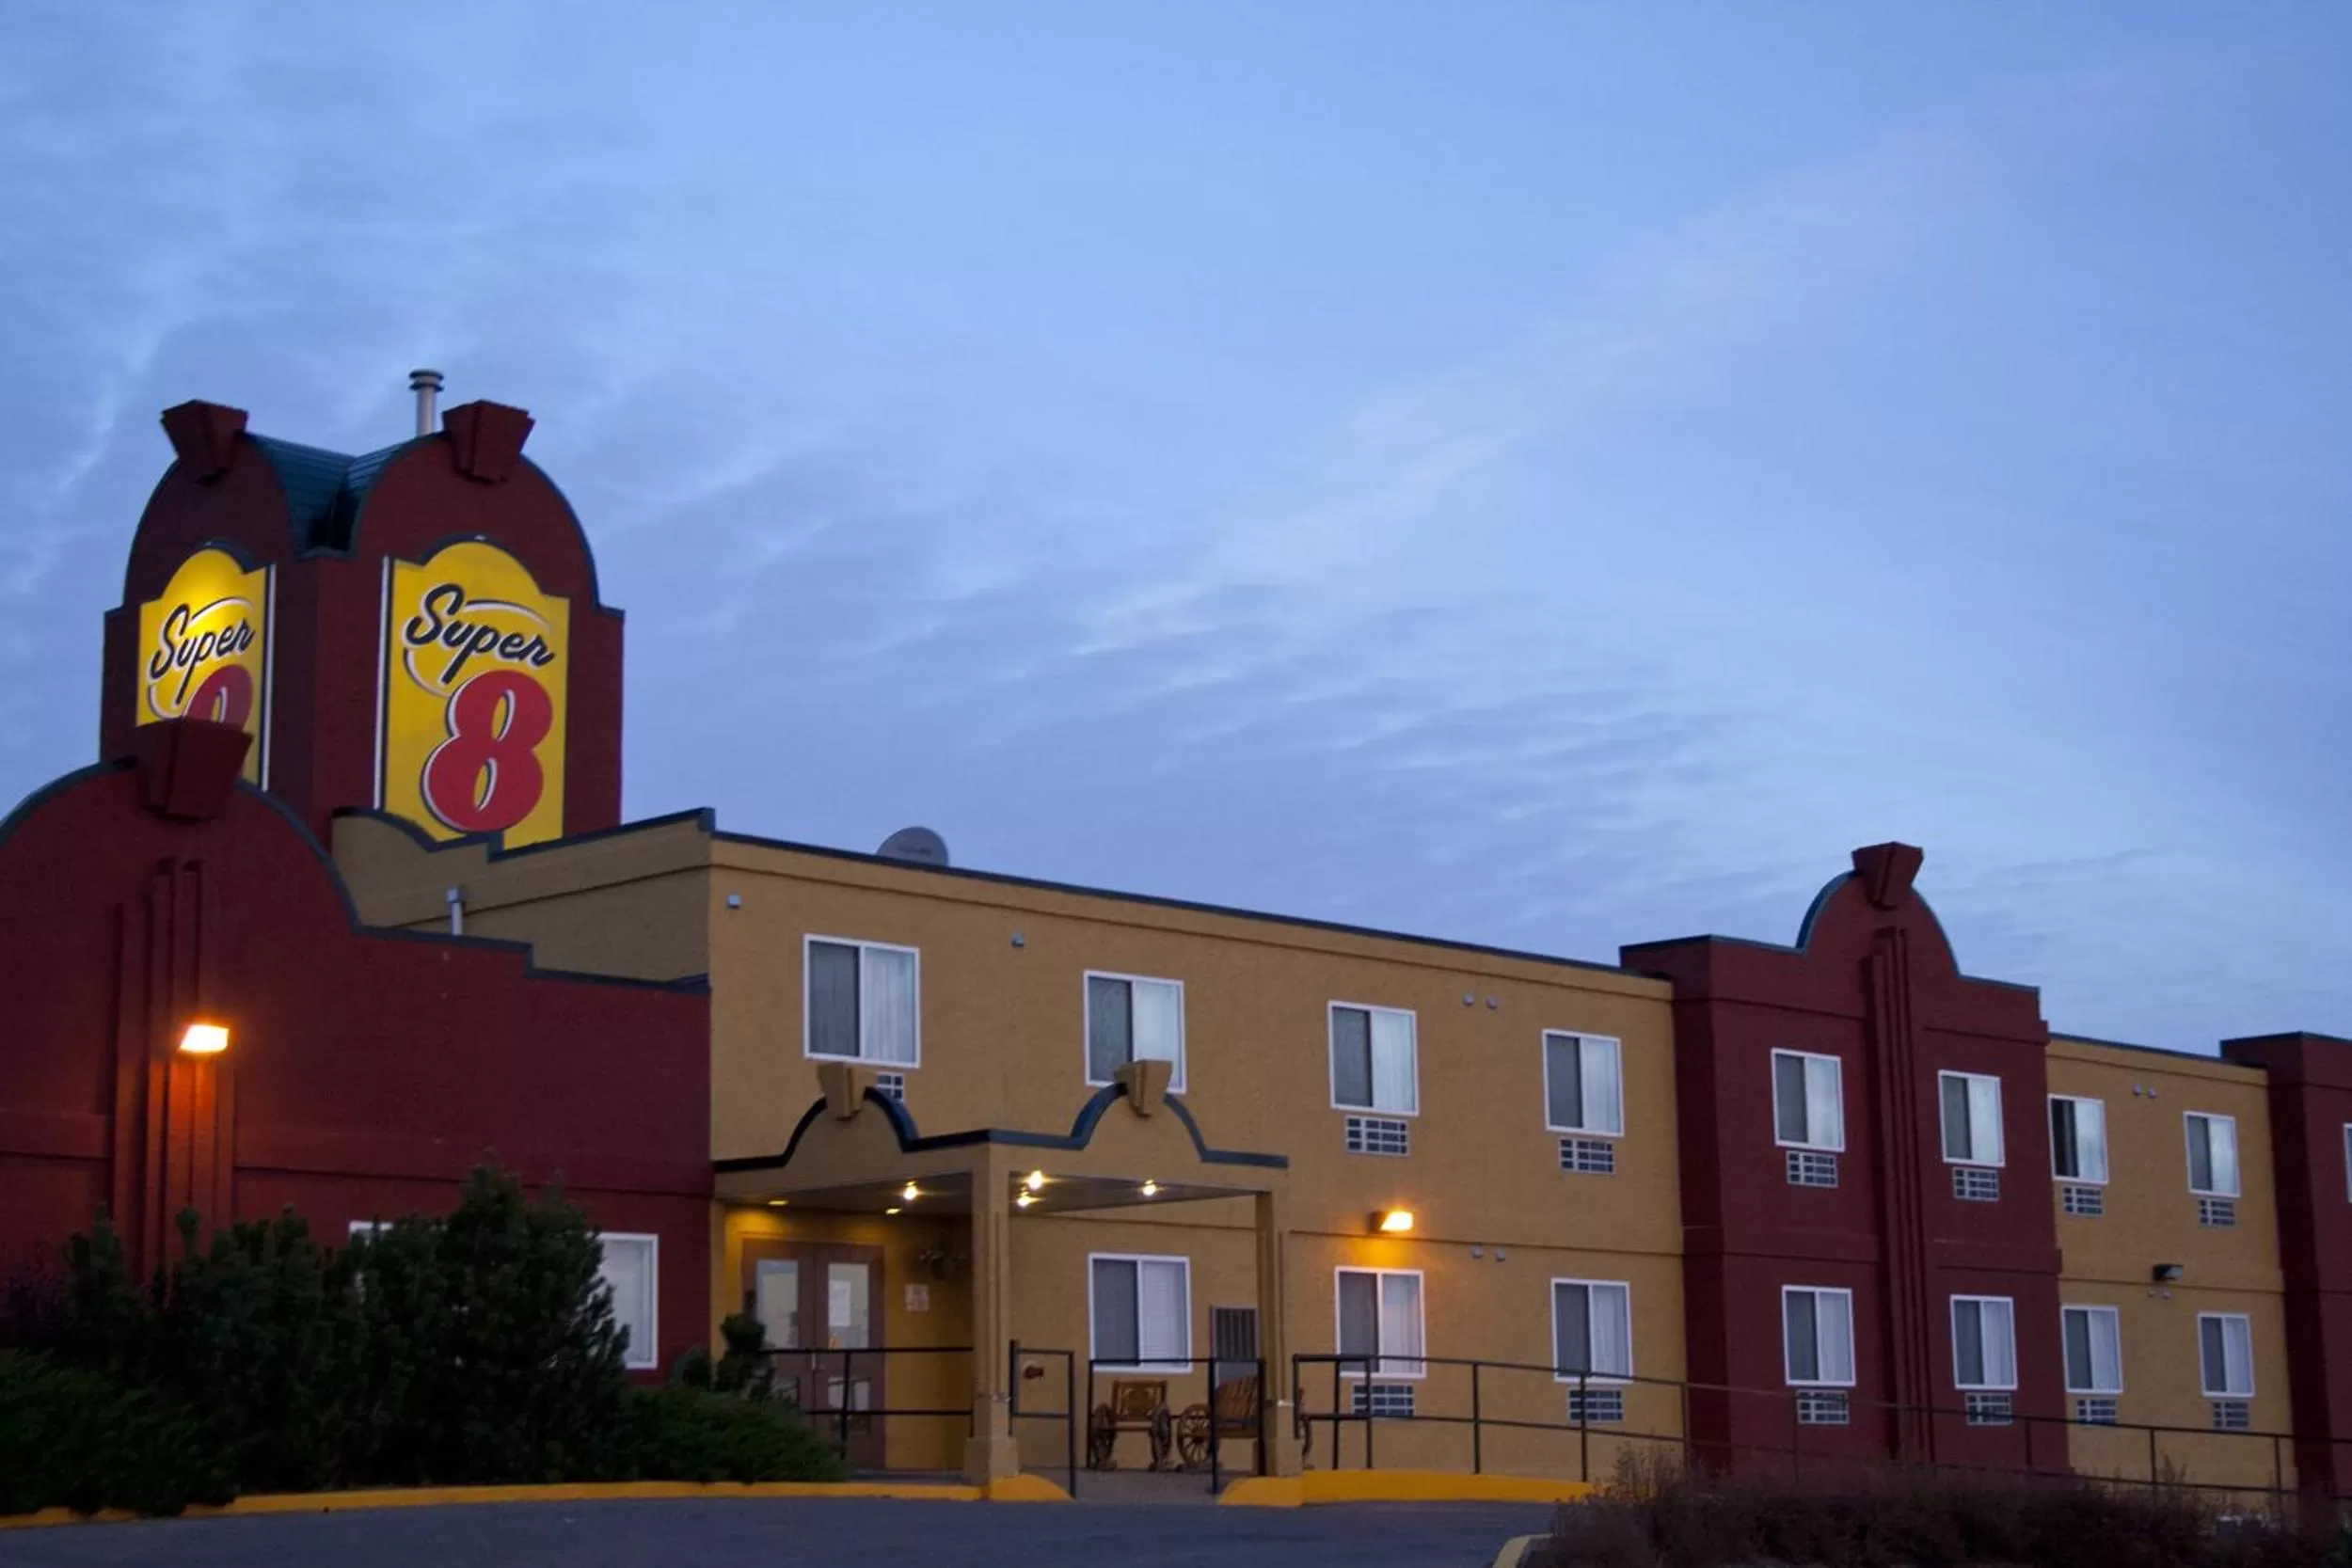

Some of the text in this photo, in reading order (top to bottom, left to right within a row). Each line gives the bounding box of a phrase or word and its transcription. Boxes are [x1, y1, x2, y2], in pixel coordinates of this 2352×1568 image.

[149, 602, 255, 705] Super
[404, 582, 555, 686] Super
[420, 668, 554, 832] 8
